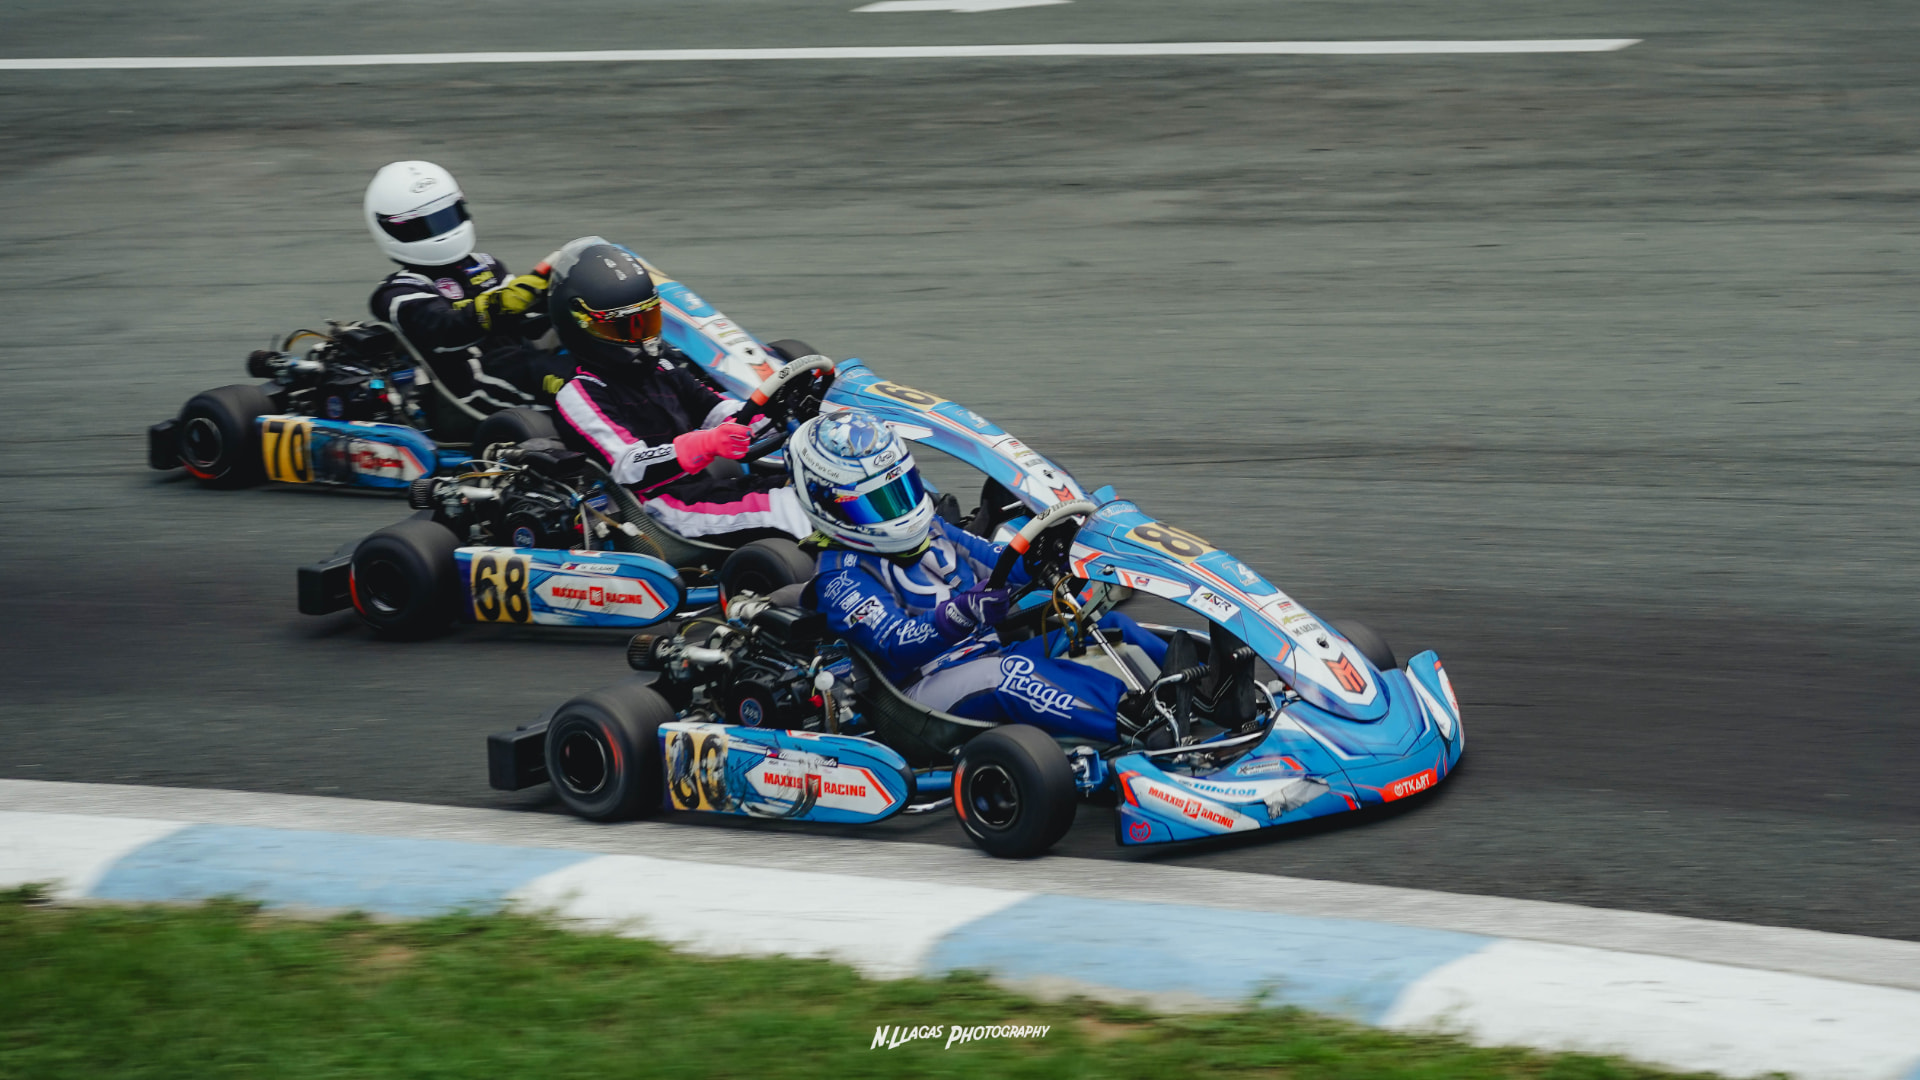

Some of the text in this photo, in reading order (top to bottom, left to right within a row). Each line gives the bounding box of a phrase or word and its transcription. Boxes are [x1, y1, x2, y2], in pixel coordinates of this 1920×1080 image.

[265, 421, 309, 480] 70
[475, 555, 530, 623] 68
[998, 655, 1073, 719] Praga
[764, 772, 866, 797] MAXXIS RACING
[1148, 786, 1235, 830] MAXXIS RACING
[1402, 773, 1430, 794] TKART
